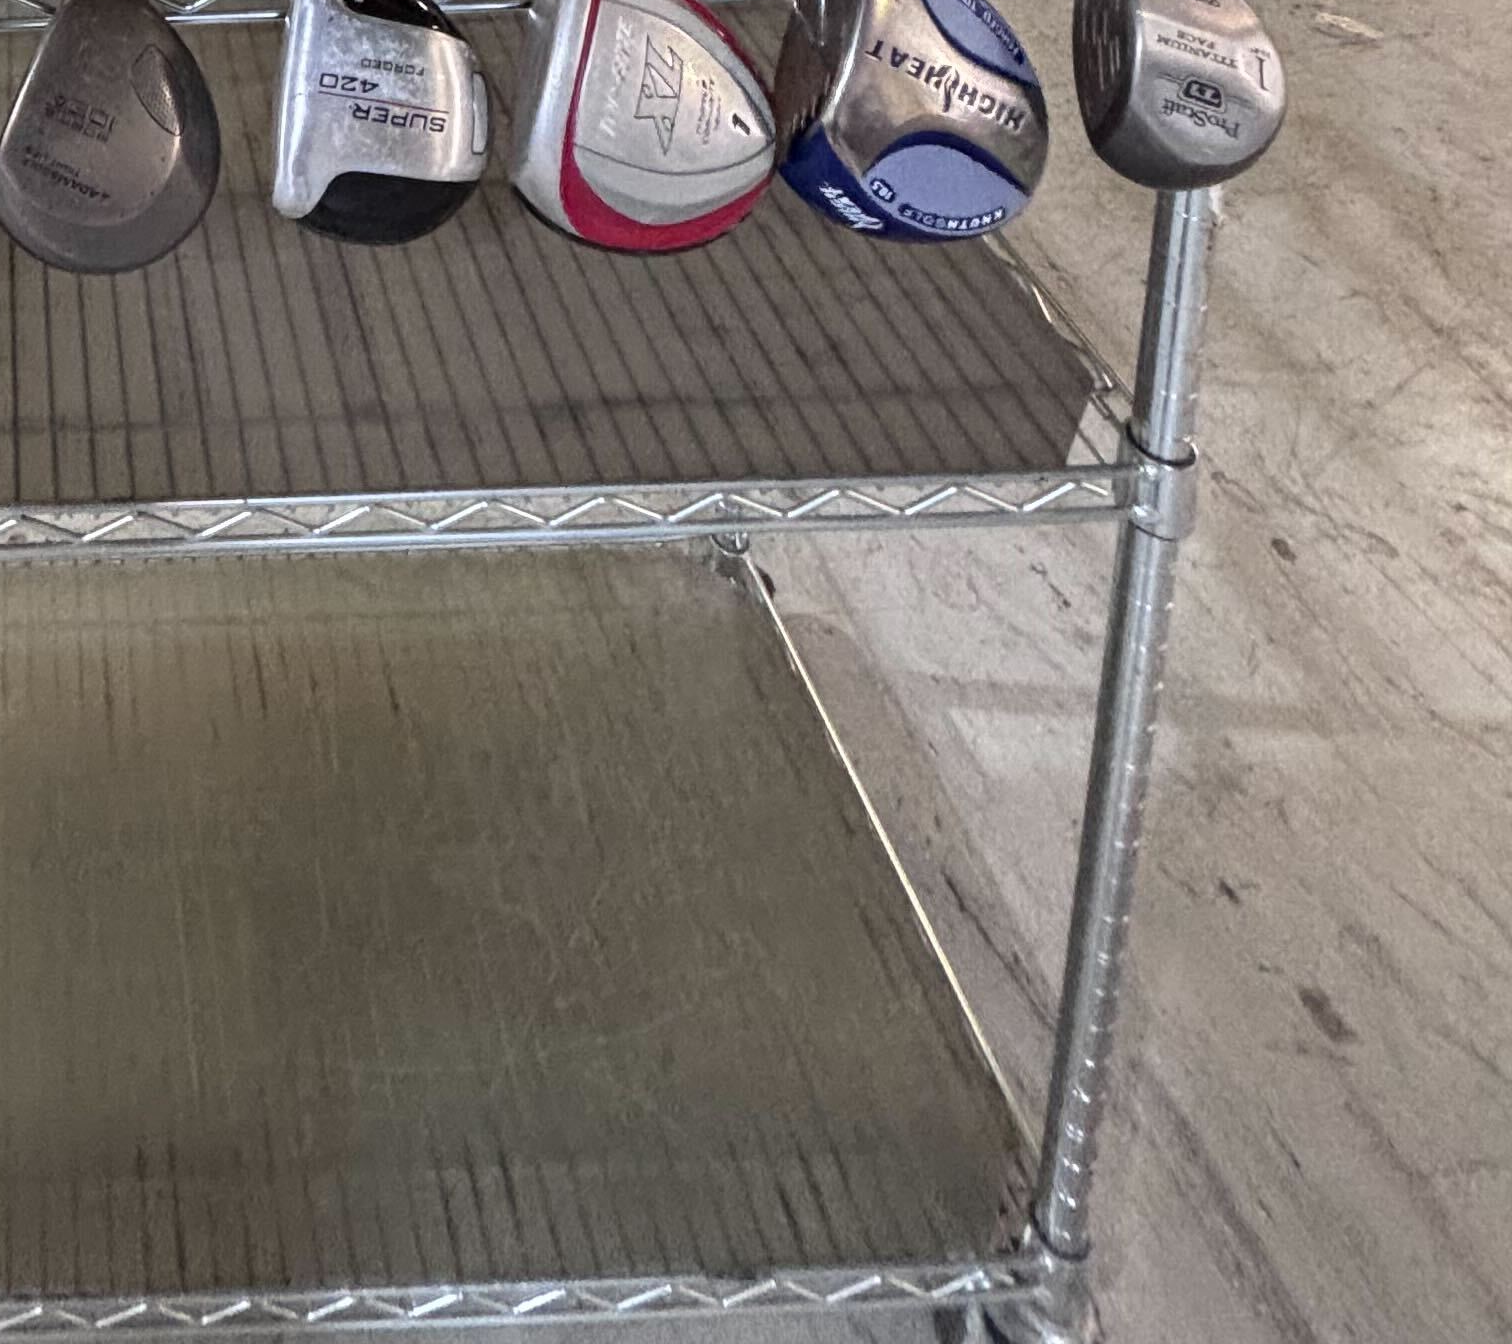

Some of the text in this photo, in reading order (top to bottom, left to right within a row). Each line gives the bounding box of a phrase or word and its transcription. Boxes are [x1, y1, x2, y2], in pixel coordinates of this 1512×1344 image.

[1176, 30, 1217, 50] FACE
[1156, 34, 1240, 69] TITANIUM
[359, 57, 427, 77] FORGED
[318, 72, 381, 94] 420
[350, 103, 448, 134] SUPER
